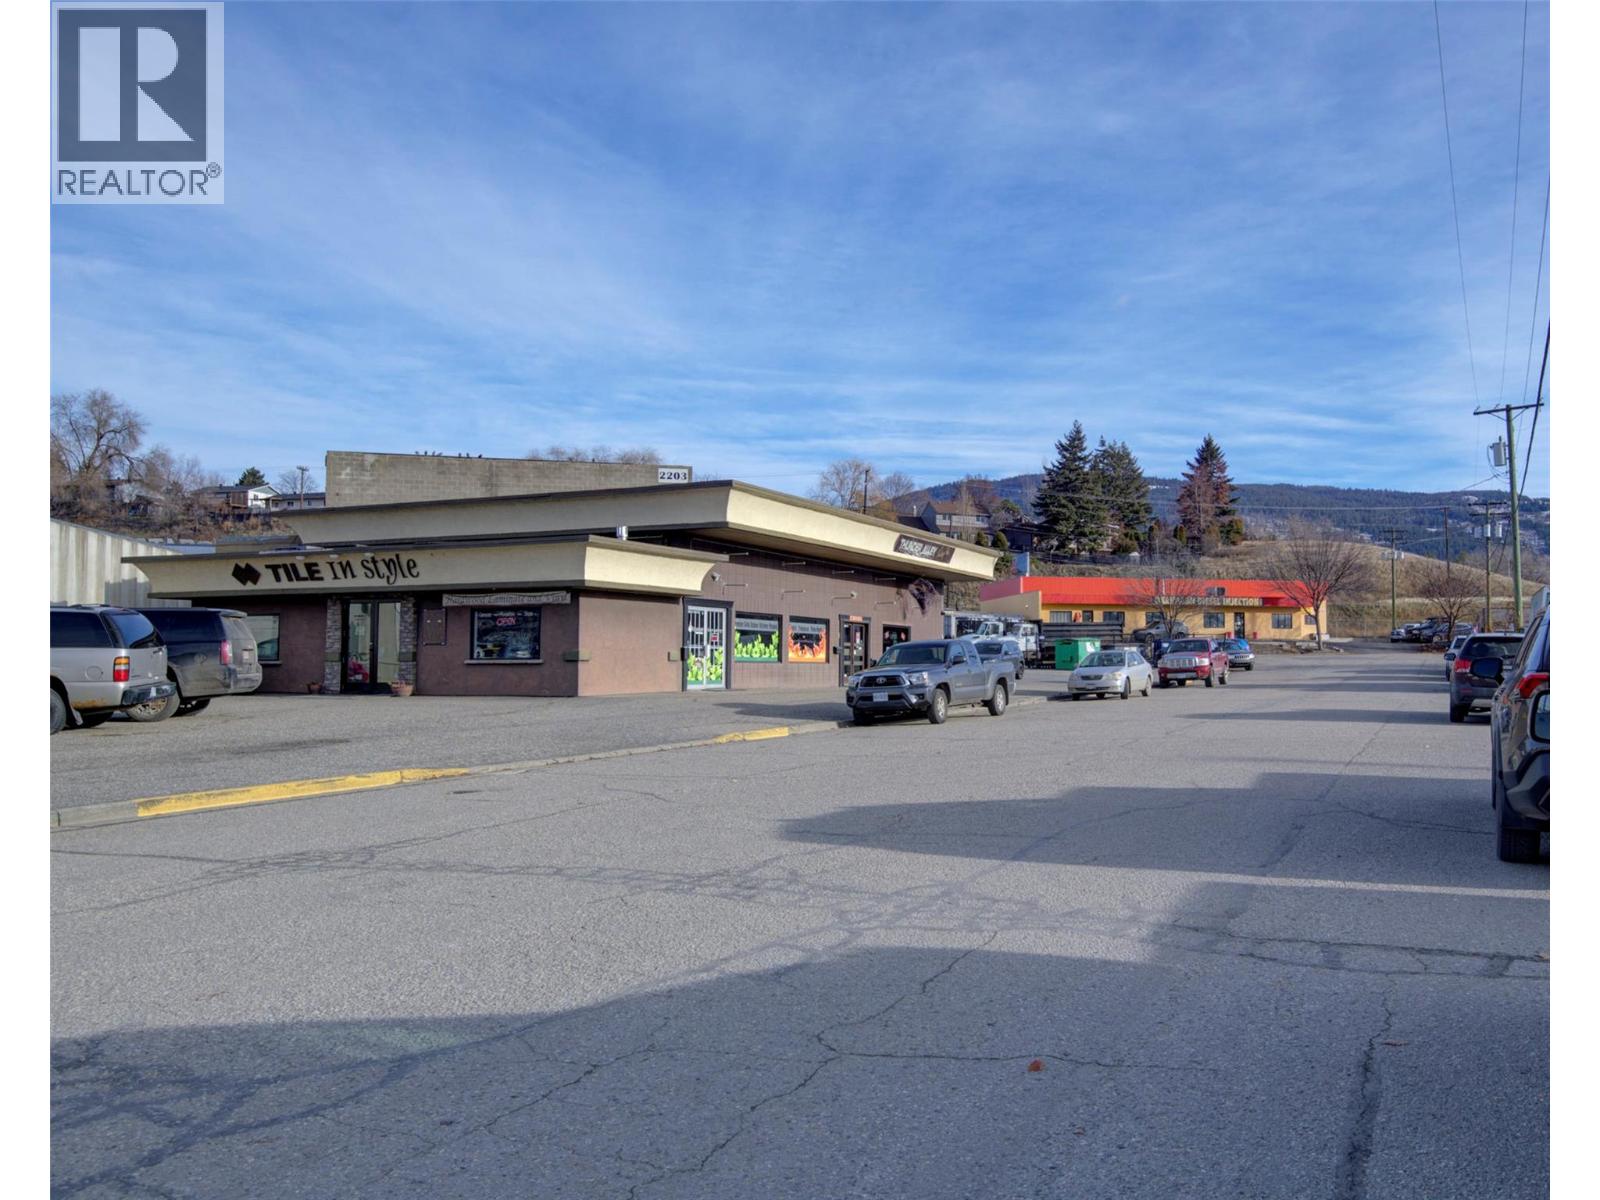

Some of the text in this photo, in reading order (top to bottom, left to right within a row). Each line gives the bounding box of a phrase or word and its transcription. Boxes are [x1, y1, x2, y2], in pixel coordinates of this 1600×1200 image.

[660, 471, 687, 480] 2203
[265, 562, 324, 582] TILE
[361, 553, 420, 585] style
[1222, 597, 1259, 606] INJECTION
[496, 617, 516, 626] OPEN
